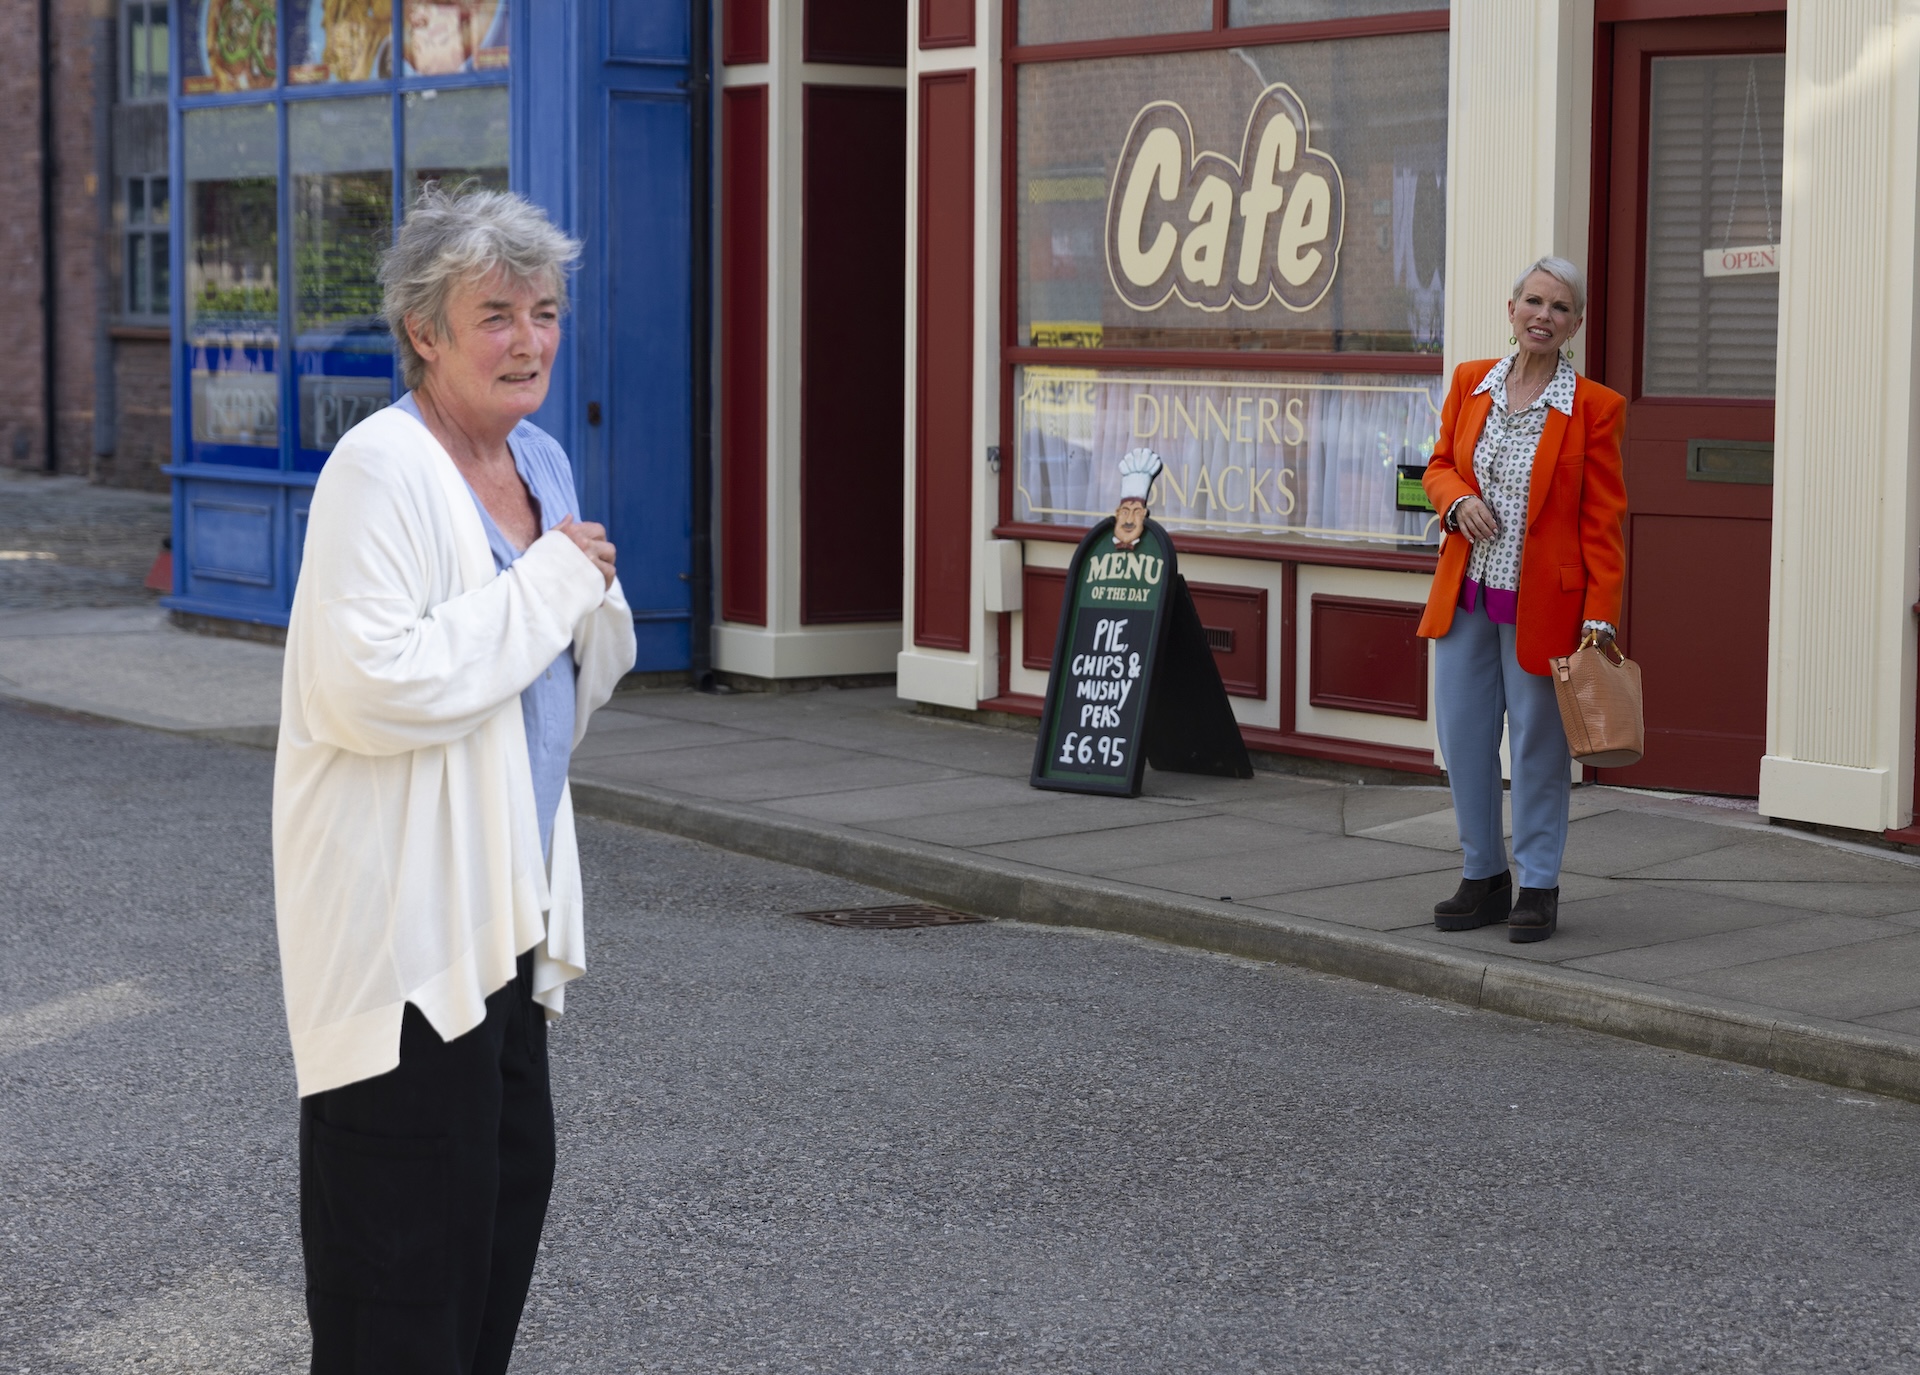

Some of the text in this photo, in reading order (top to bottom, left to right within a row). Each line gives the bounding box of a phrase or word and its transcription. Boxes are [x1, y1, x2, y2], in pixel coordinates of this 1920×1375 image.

[1118, 112, 1331, 287] Cafe
[1722, 249, 1776, 270] OPEN
[1133, 393, 1304, 446] DINNERS
[1086, 552, 1164, 585] MENU
[1091, 586, 1151, 602] OF THE DAY
[1093, 618, 1129, 653] PIE,
[1071, 652, 1142, 679] CHIPS &
[1076, 679, 1133, 711] MUSHY
[1080, 703, 1121, 729] PEAS
[1059, 731, 1127, 767] £6.95
